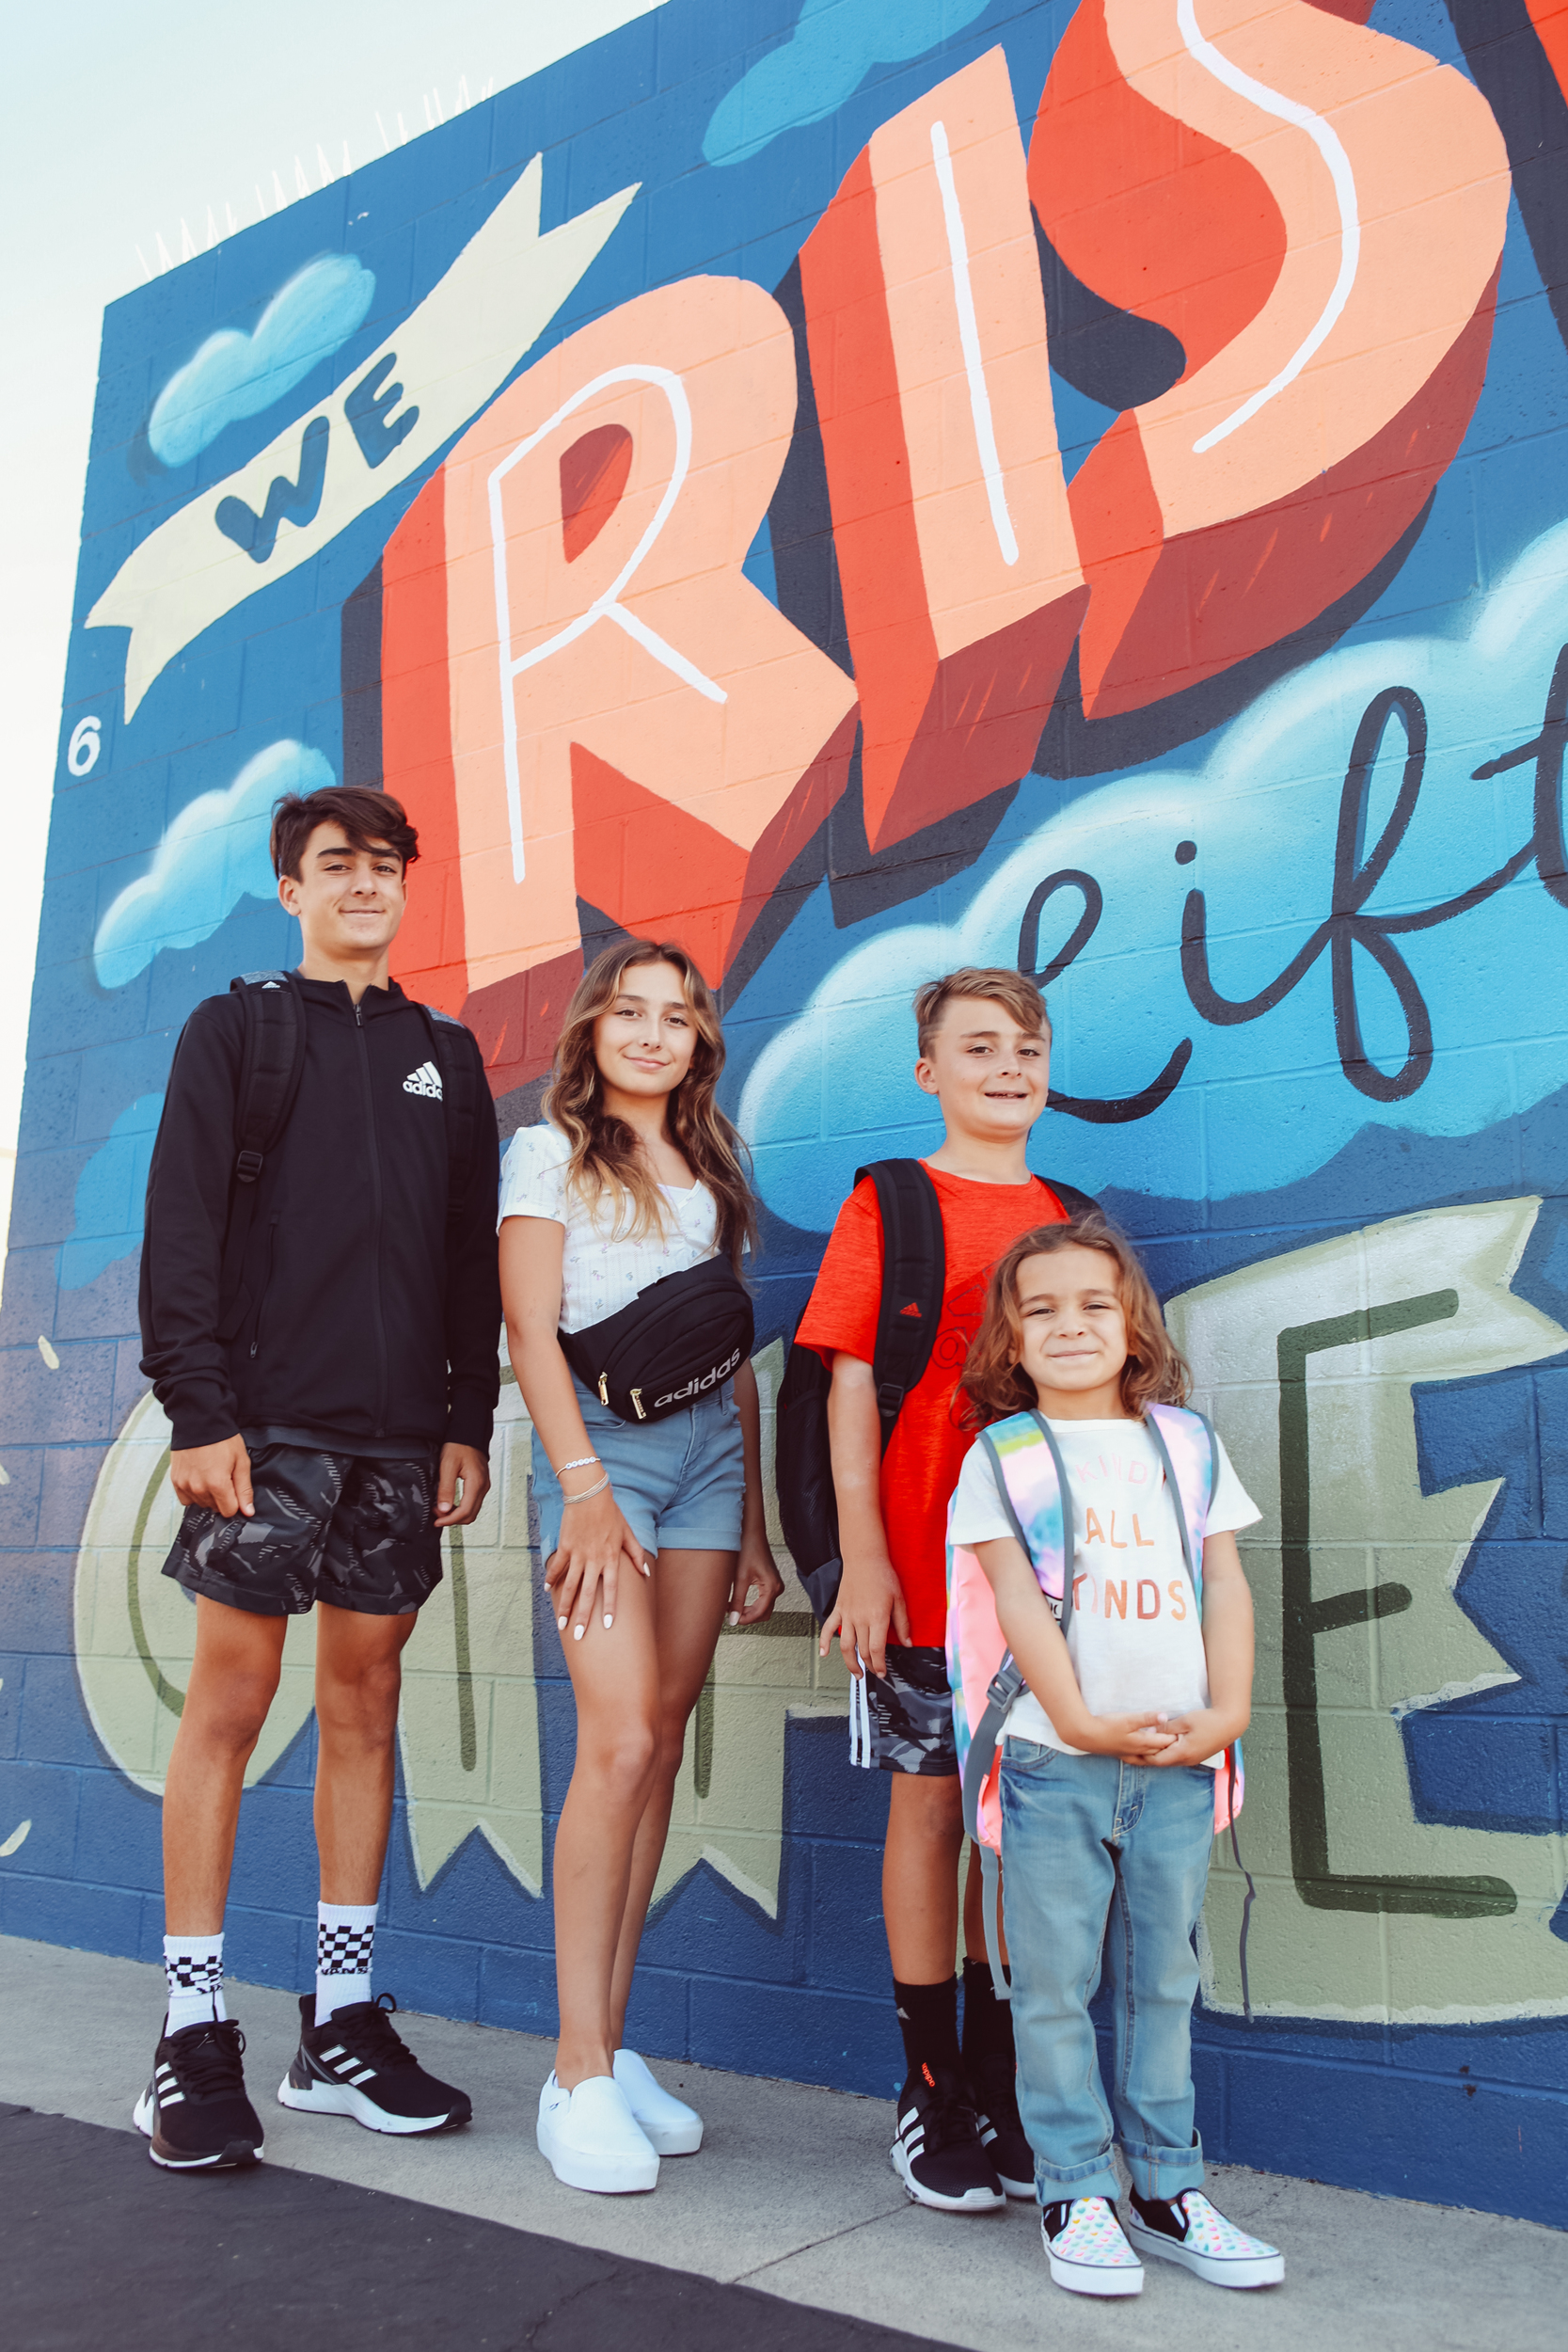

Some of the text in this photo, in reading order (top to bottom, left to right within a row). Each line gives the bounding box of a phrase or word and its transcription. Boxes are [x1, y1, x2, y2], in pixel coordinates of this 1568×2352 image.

[214, 352, 420, 564] WE
[381, 0, 1568, 1063] RIS
[67, 716, 102, 777] 6
[402, 1080, 443, 1102] adida
[654, 1347, 740, 1408] adidas
[1085, 1507, 1155, 1549] ALL
